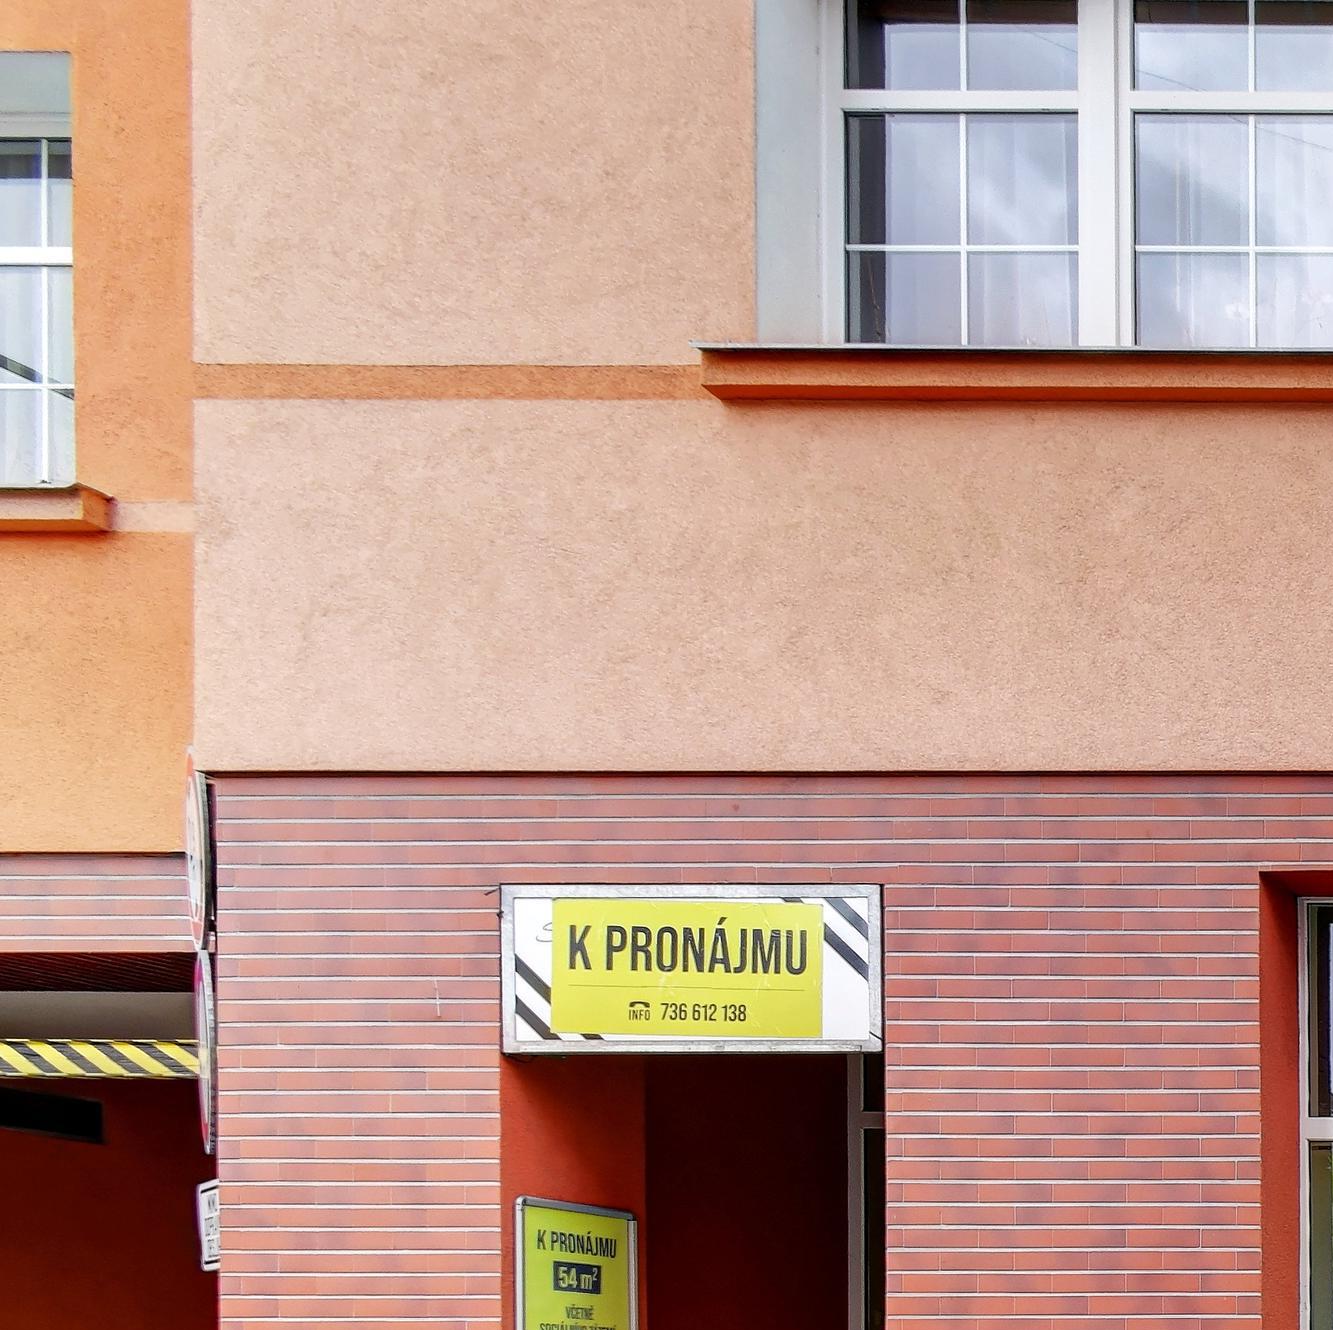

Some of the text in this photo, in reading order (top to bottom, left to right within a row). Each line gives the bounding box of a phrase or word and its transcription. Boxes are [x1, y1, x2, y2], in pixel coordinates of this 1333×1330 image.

[568, 924, 593, 970] K
[605, 916, 808, 976] PRONÁJMU
[628, 1003, 747, 1022] INFO 736 612 138
[537, 1229, 617, 1259] K PRONÁJMU
[558, 1266, 578, 1289] 54
